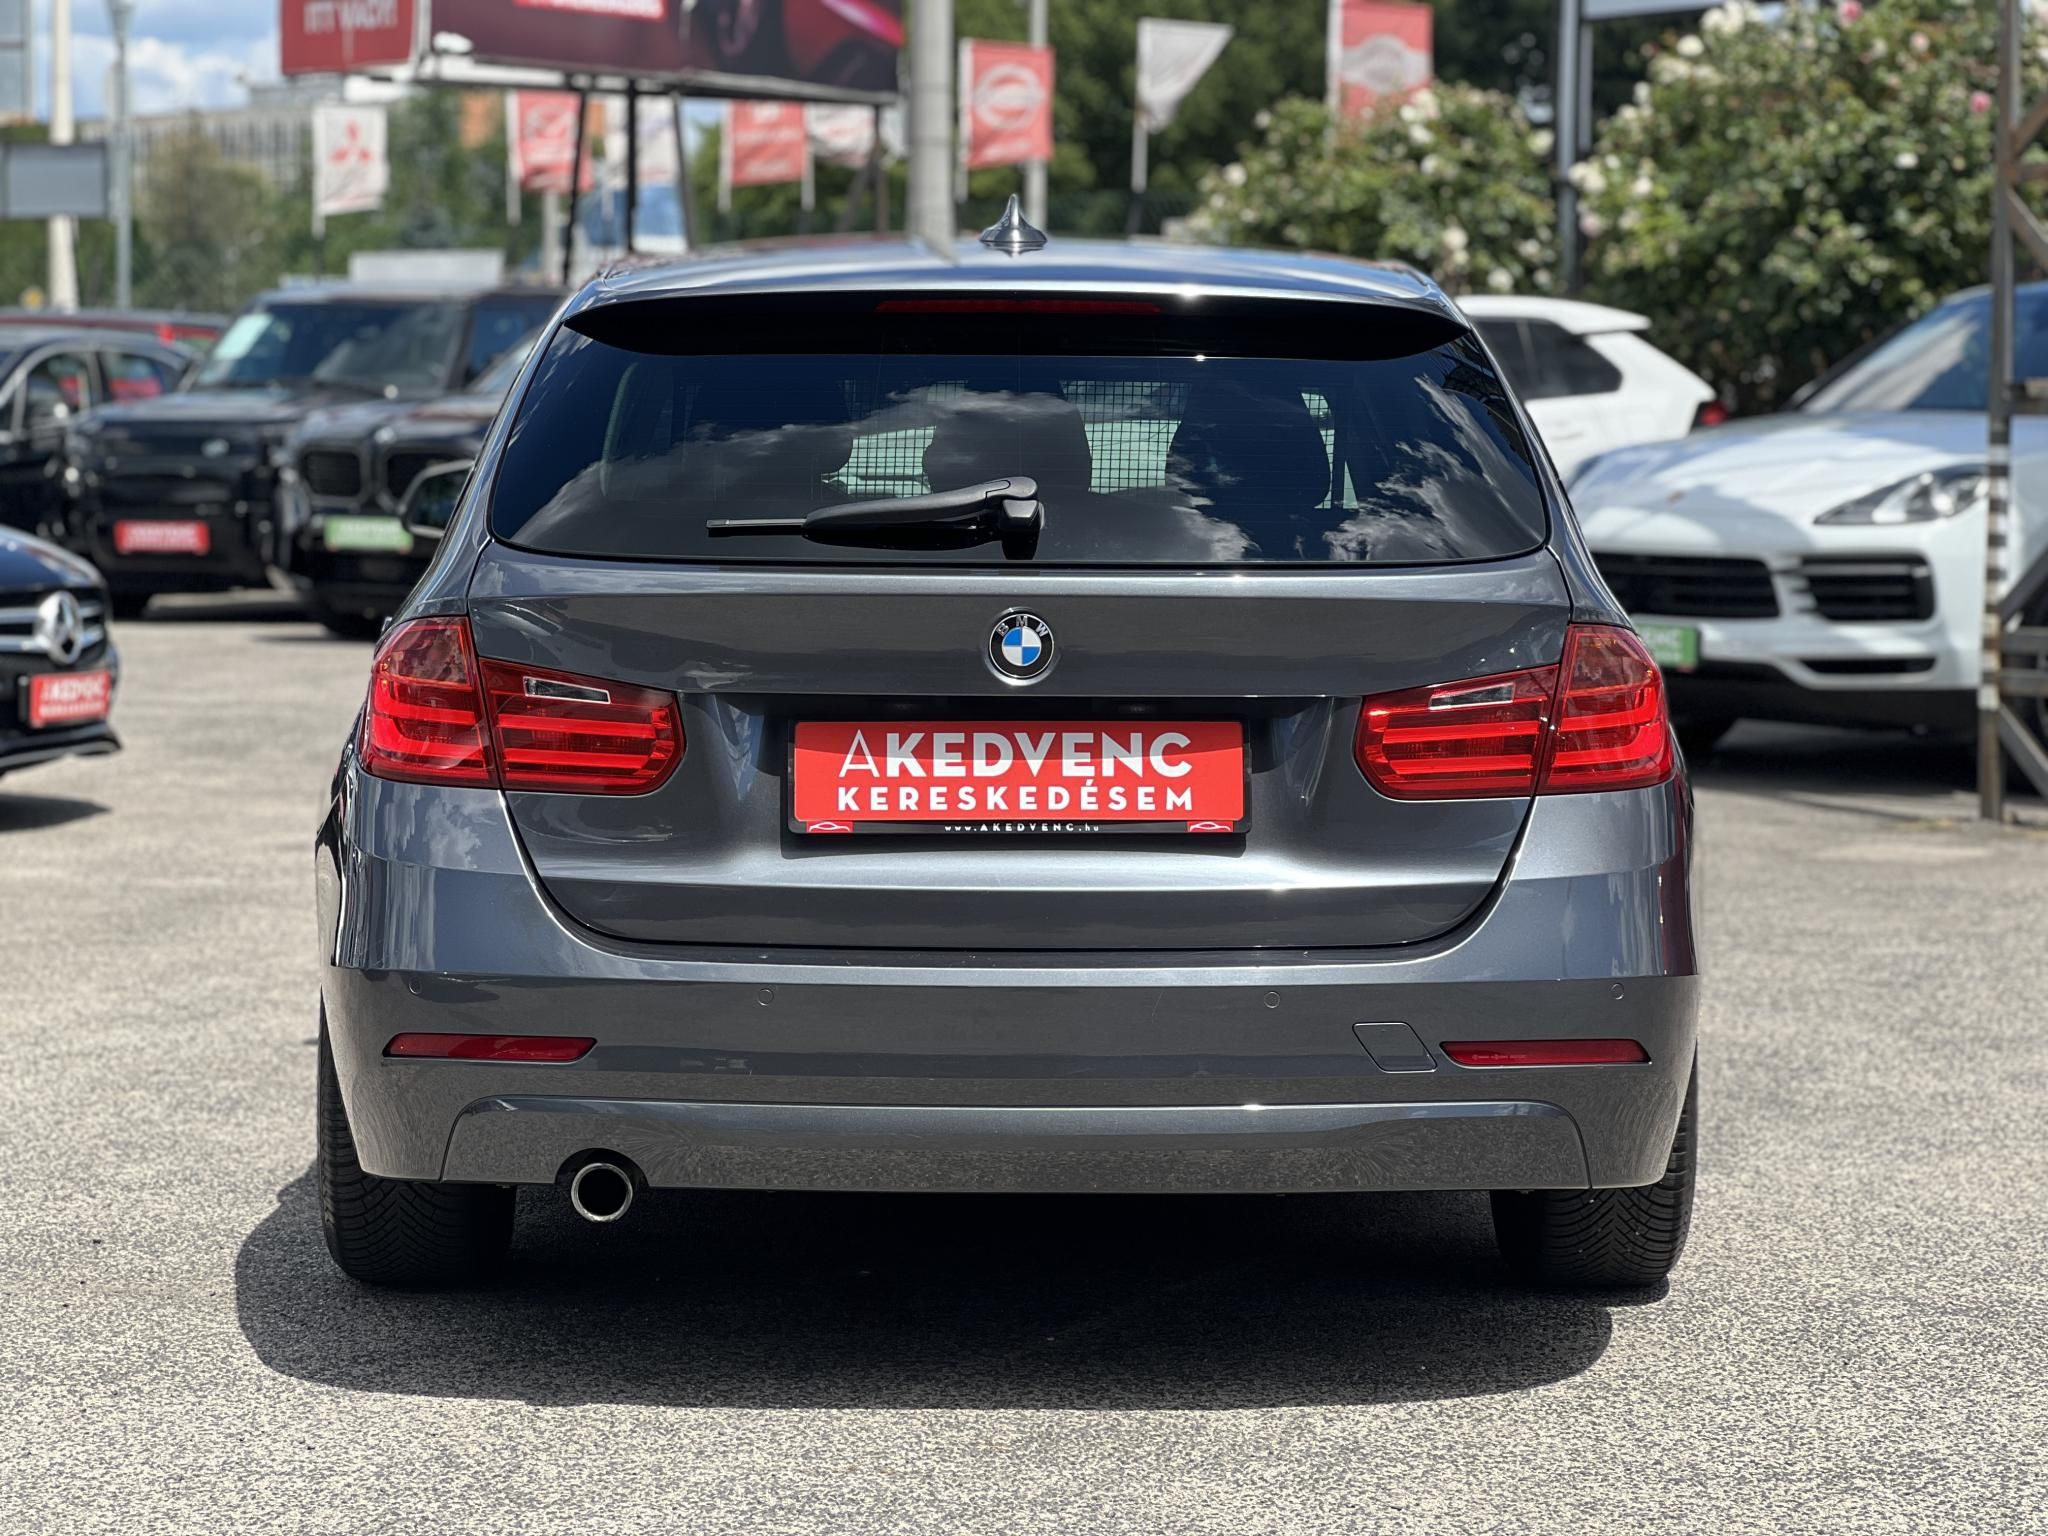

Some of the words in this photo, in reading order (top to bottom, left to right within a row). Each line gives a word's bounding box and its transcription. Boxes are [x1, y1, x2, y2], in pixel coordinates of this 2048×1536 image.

[996, 615, 1048, 637] BMW
[838, 728, 1193, 778] AKEDVENC
[837, 779, 1193, 811] KERESKEDÉSEM
[944, 823, 1099, 832] www.AKEDVENC.hu
